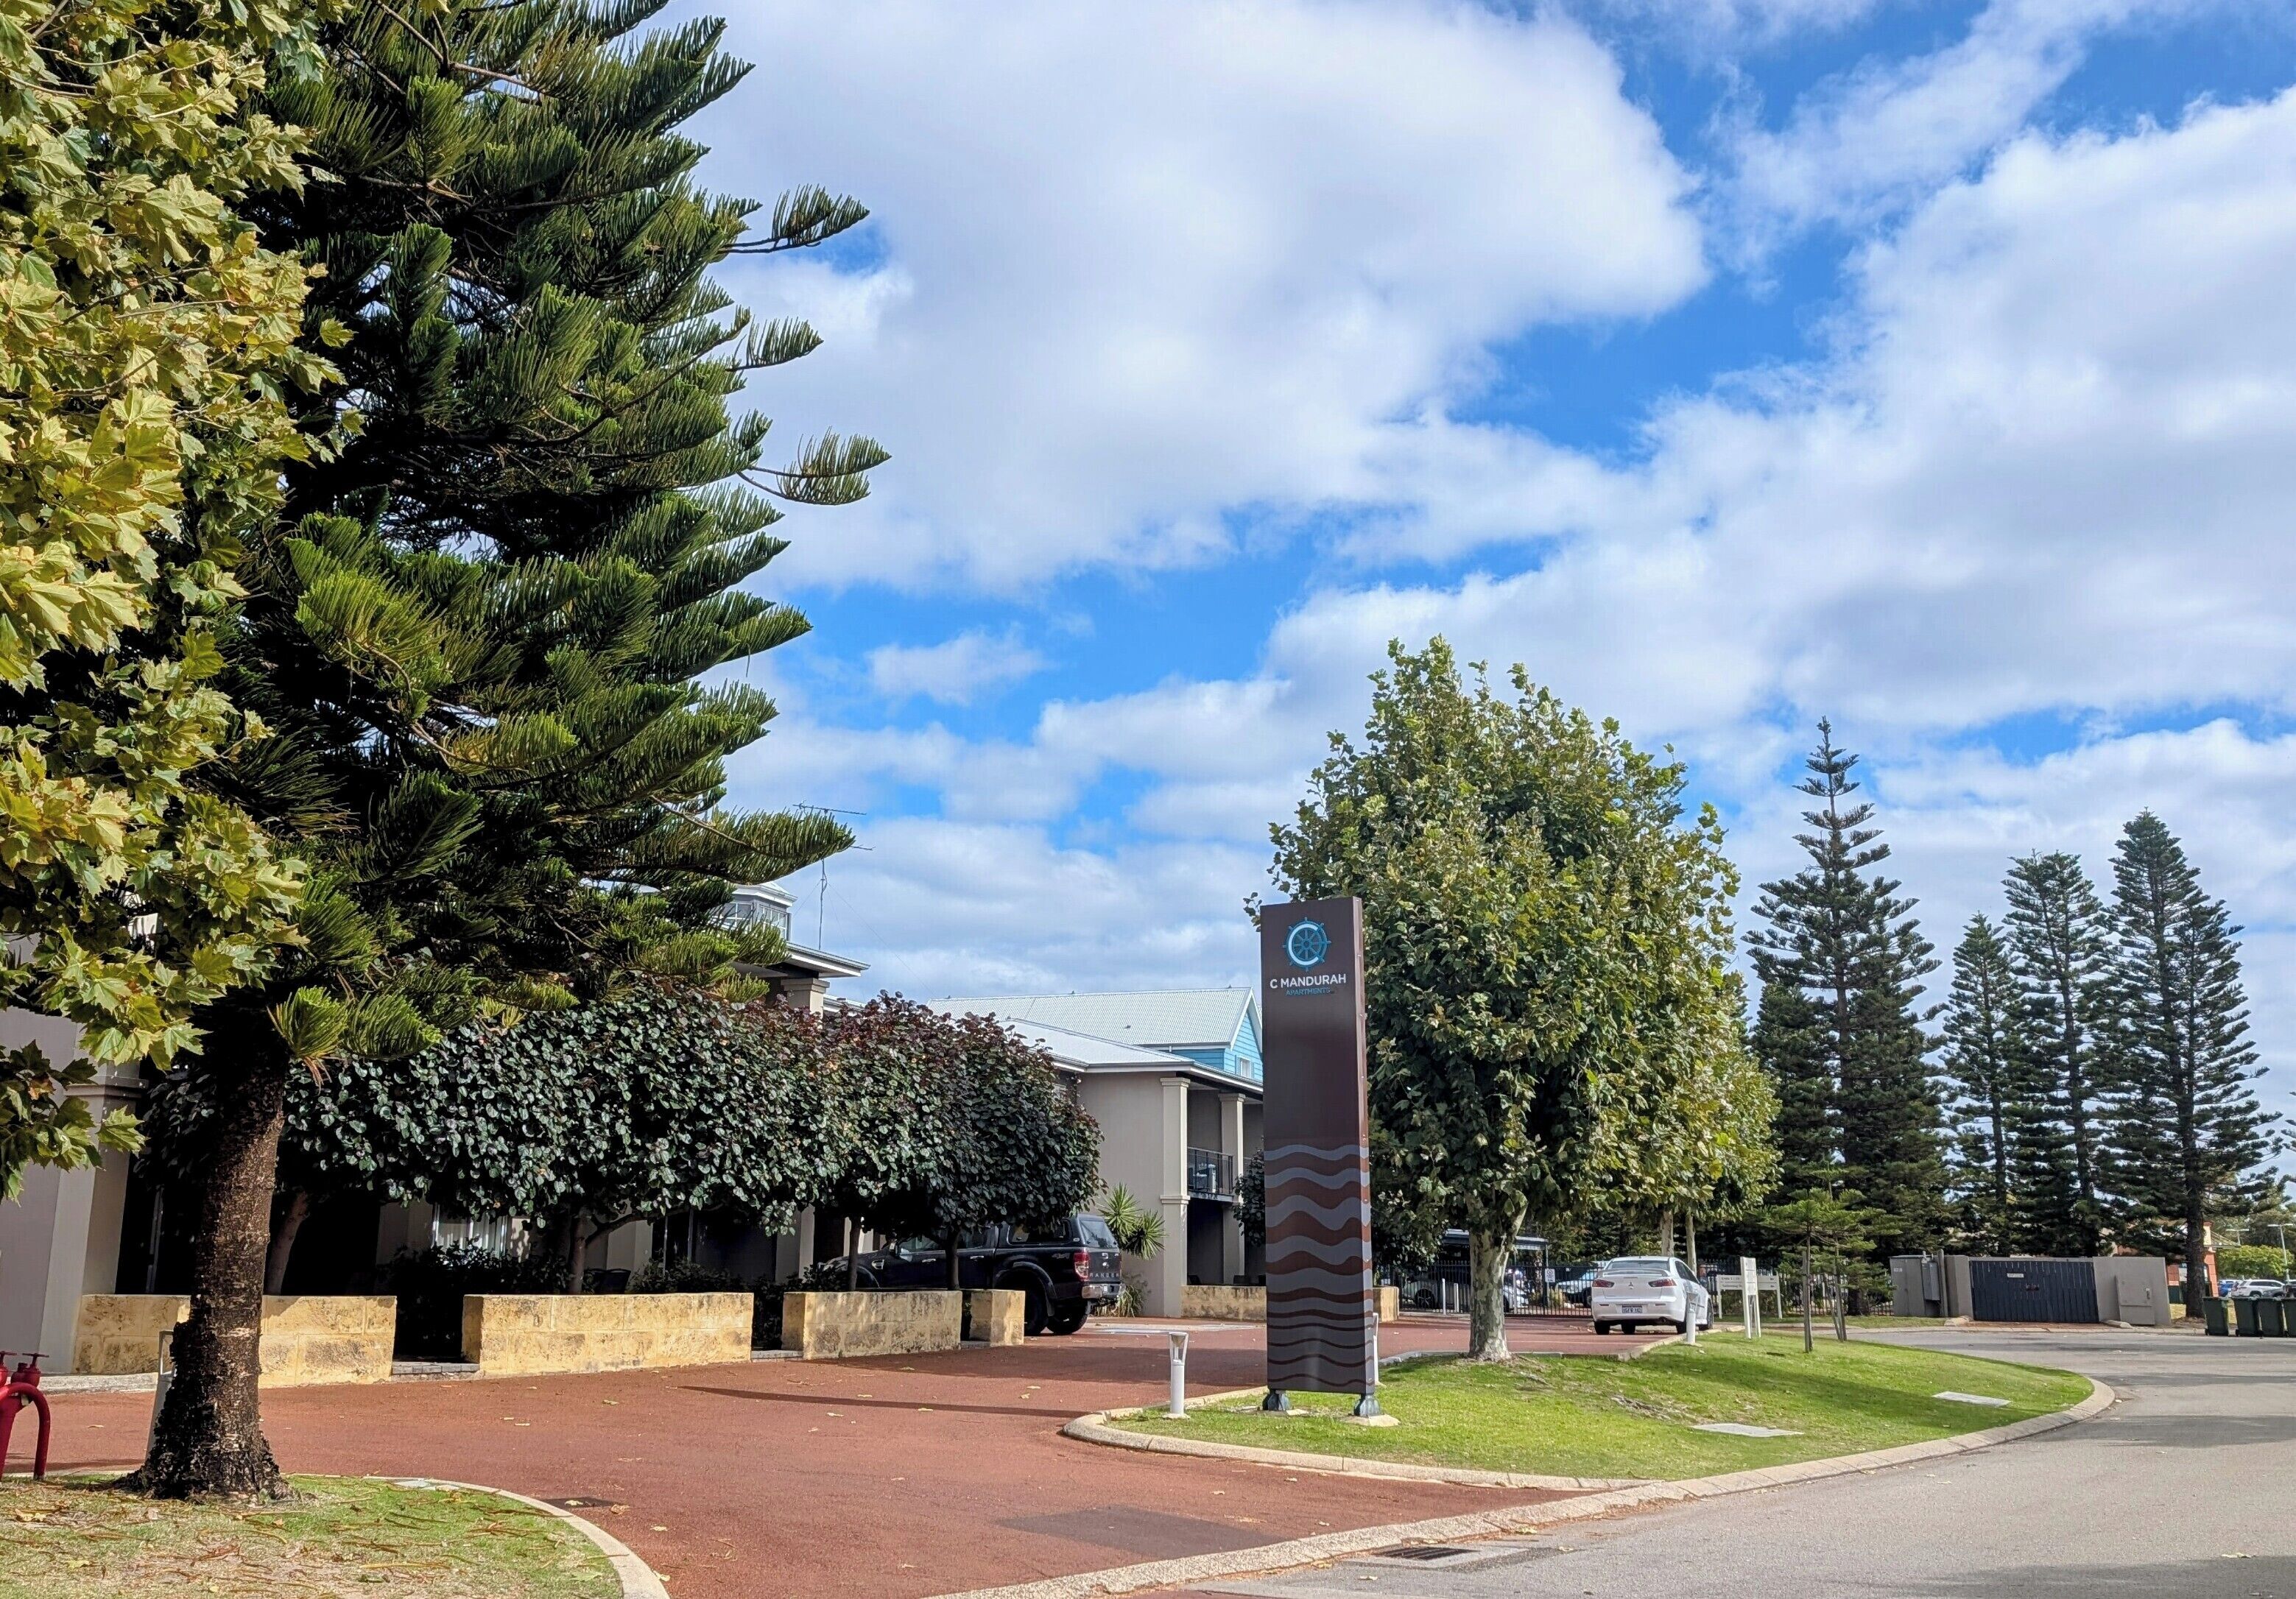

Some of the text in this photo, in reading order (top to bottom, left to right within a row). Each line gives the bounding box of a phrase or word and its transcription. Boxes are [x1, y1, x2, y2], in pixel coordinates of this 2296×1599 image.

[1270, 973, 1347, 989] C MANDURAH
[1286, 987, 1331, 996] APARTMENTS
